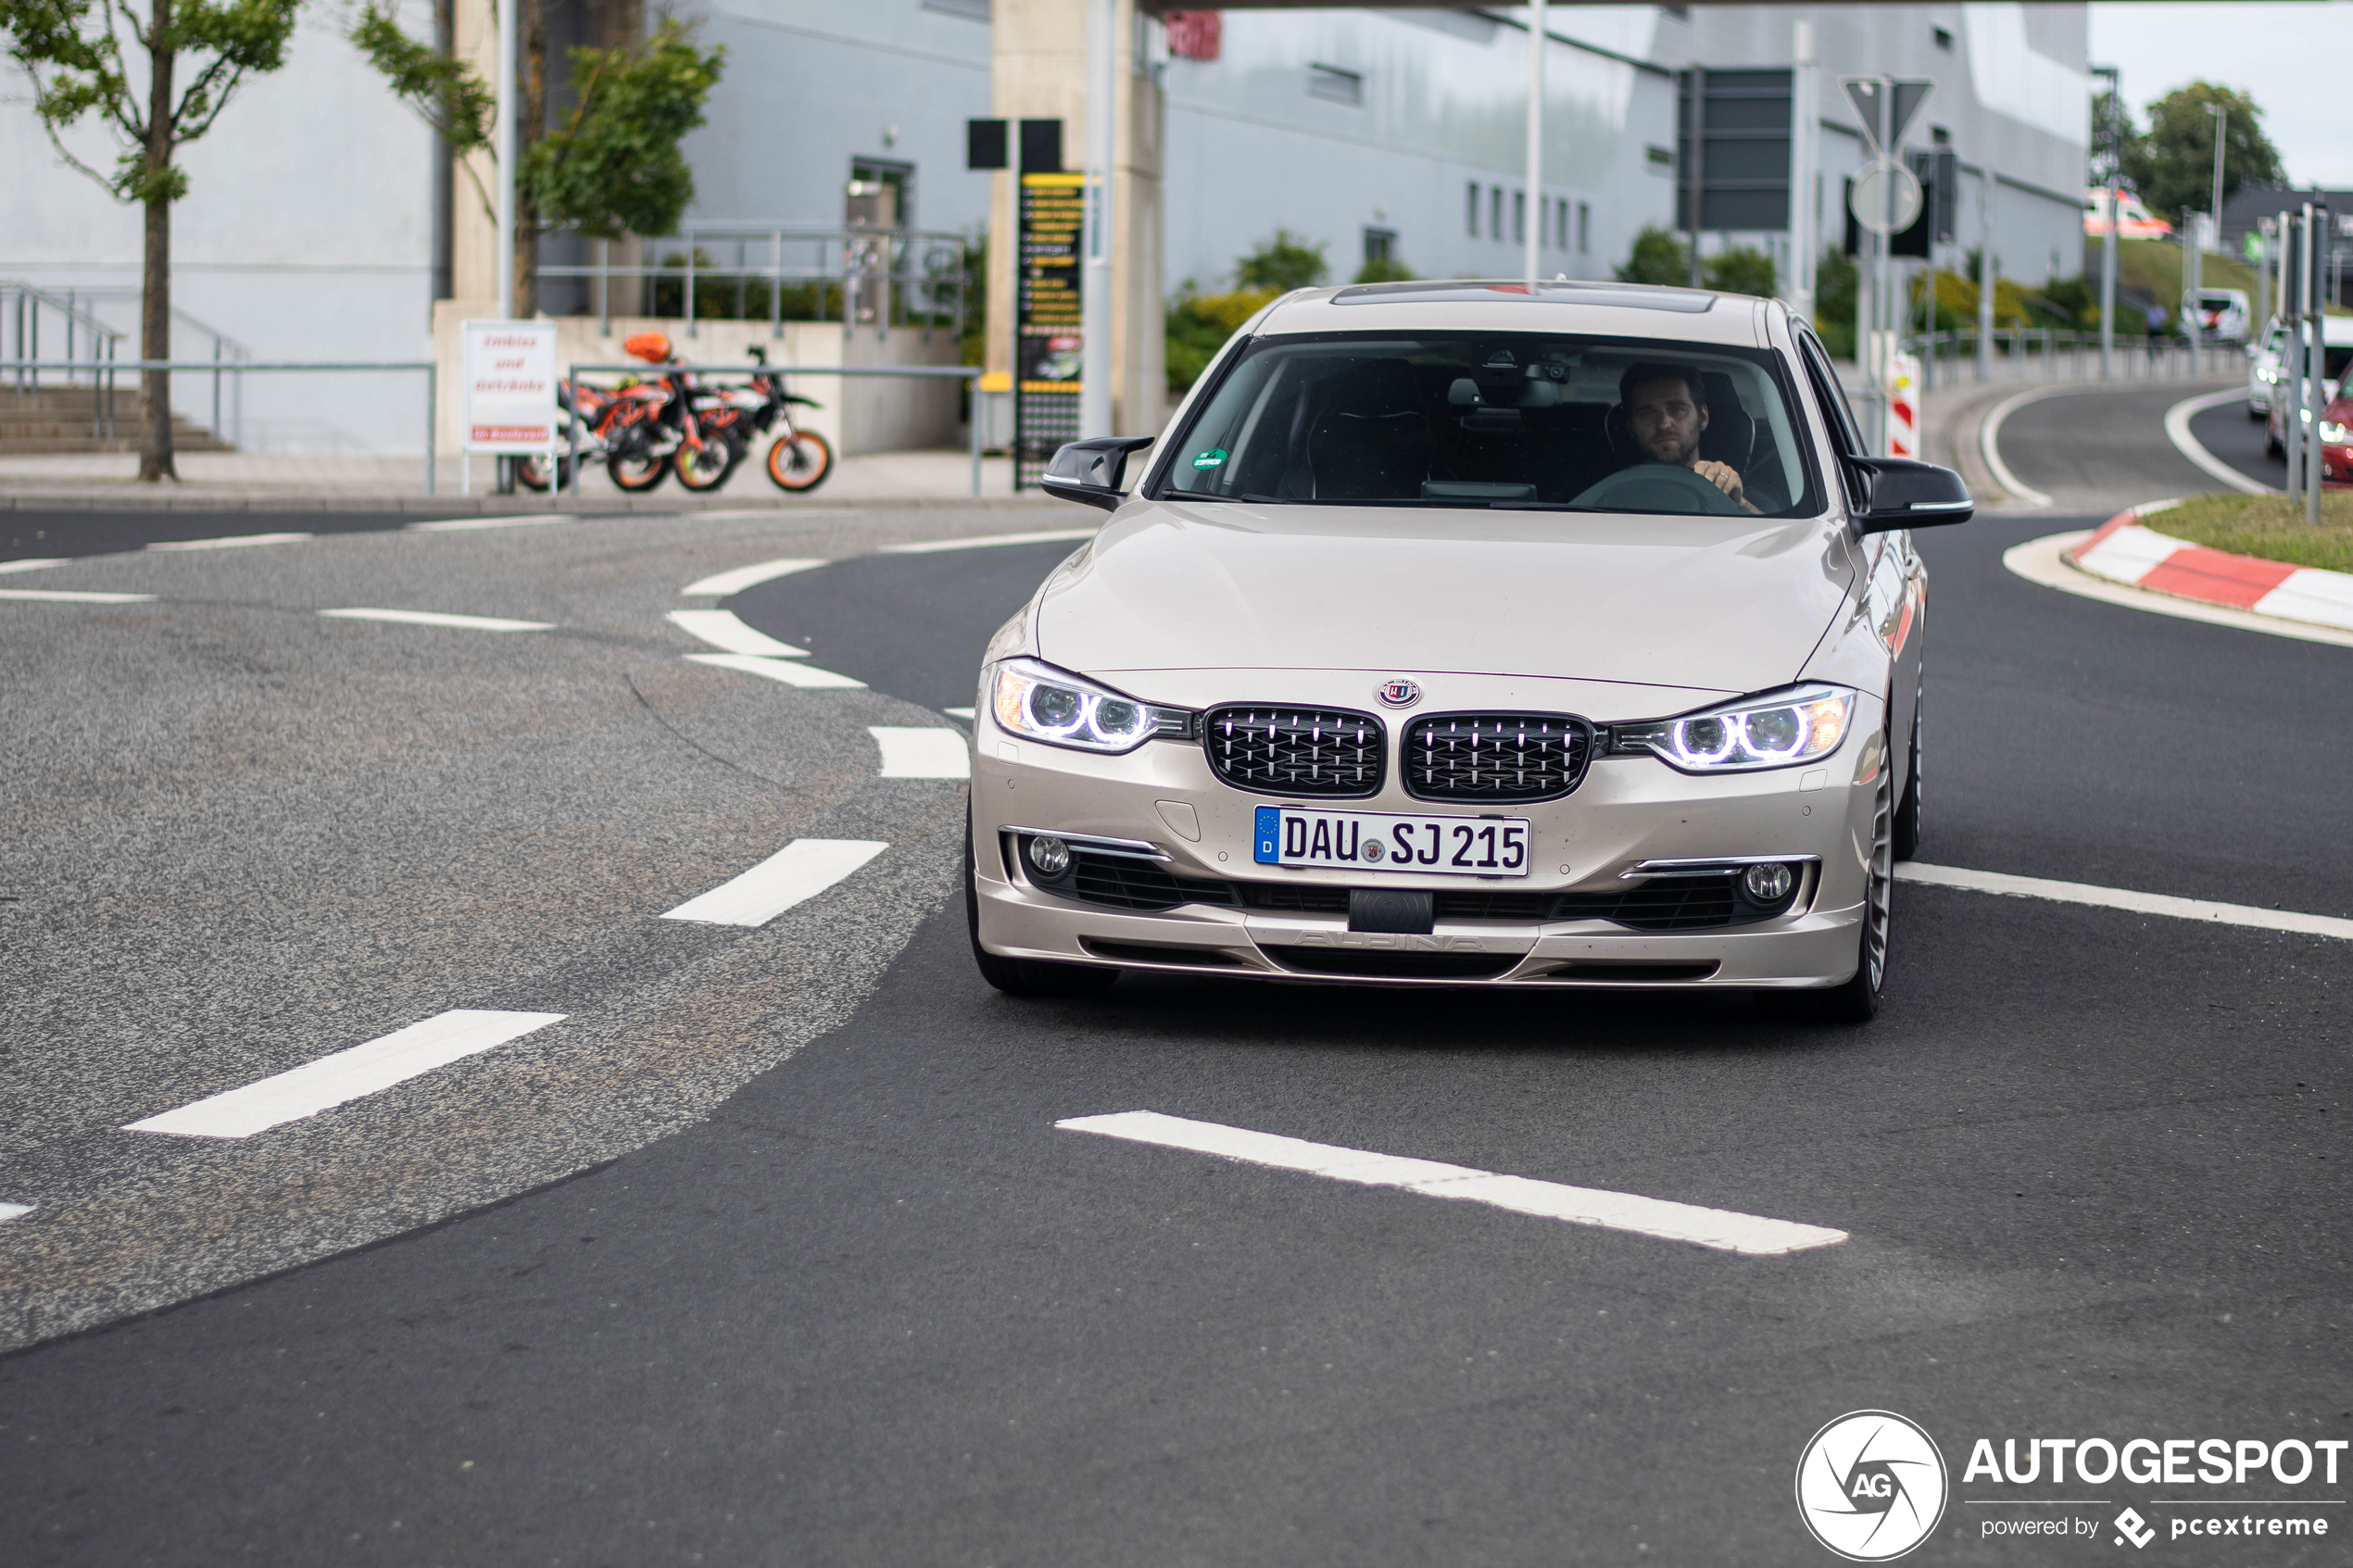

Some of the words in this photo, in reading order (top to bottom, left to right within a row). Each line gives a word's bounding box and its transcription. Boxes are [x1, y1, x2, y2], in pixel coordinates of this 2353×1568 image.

[484, 335, 536, 347] Imbiss
[496, 357, 525, 369] und
[1206, 449, 1217, 459] 4
[1262, 840, 1272, 854] D
[1284, 816, 1359, 861] DAU
[1390, 822, 1441, 865] SJ
[1452, 825, 1525, 869] 215
[1293, 929, 1488, 952] ALPINA
